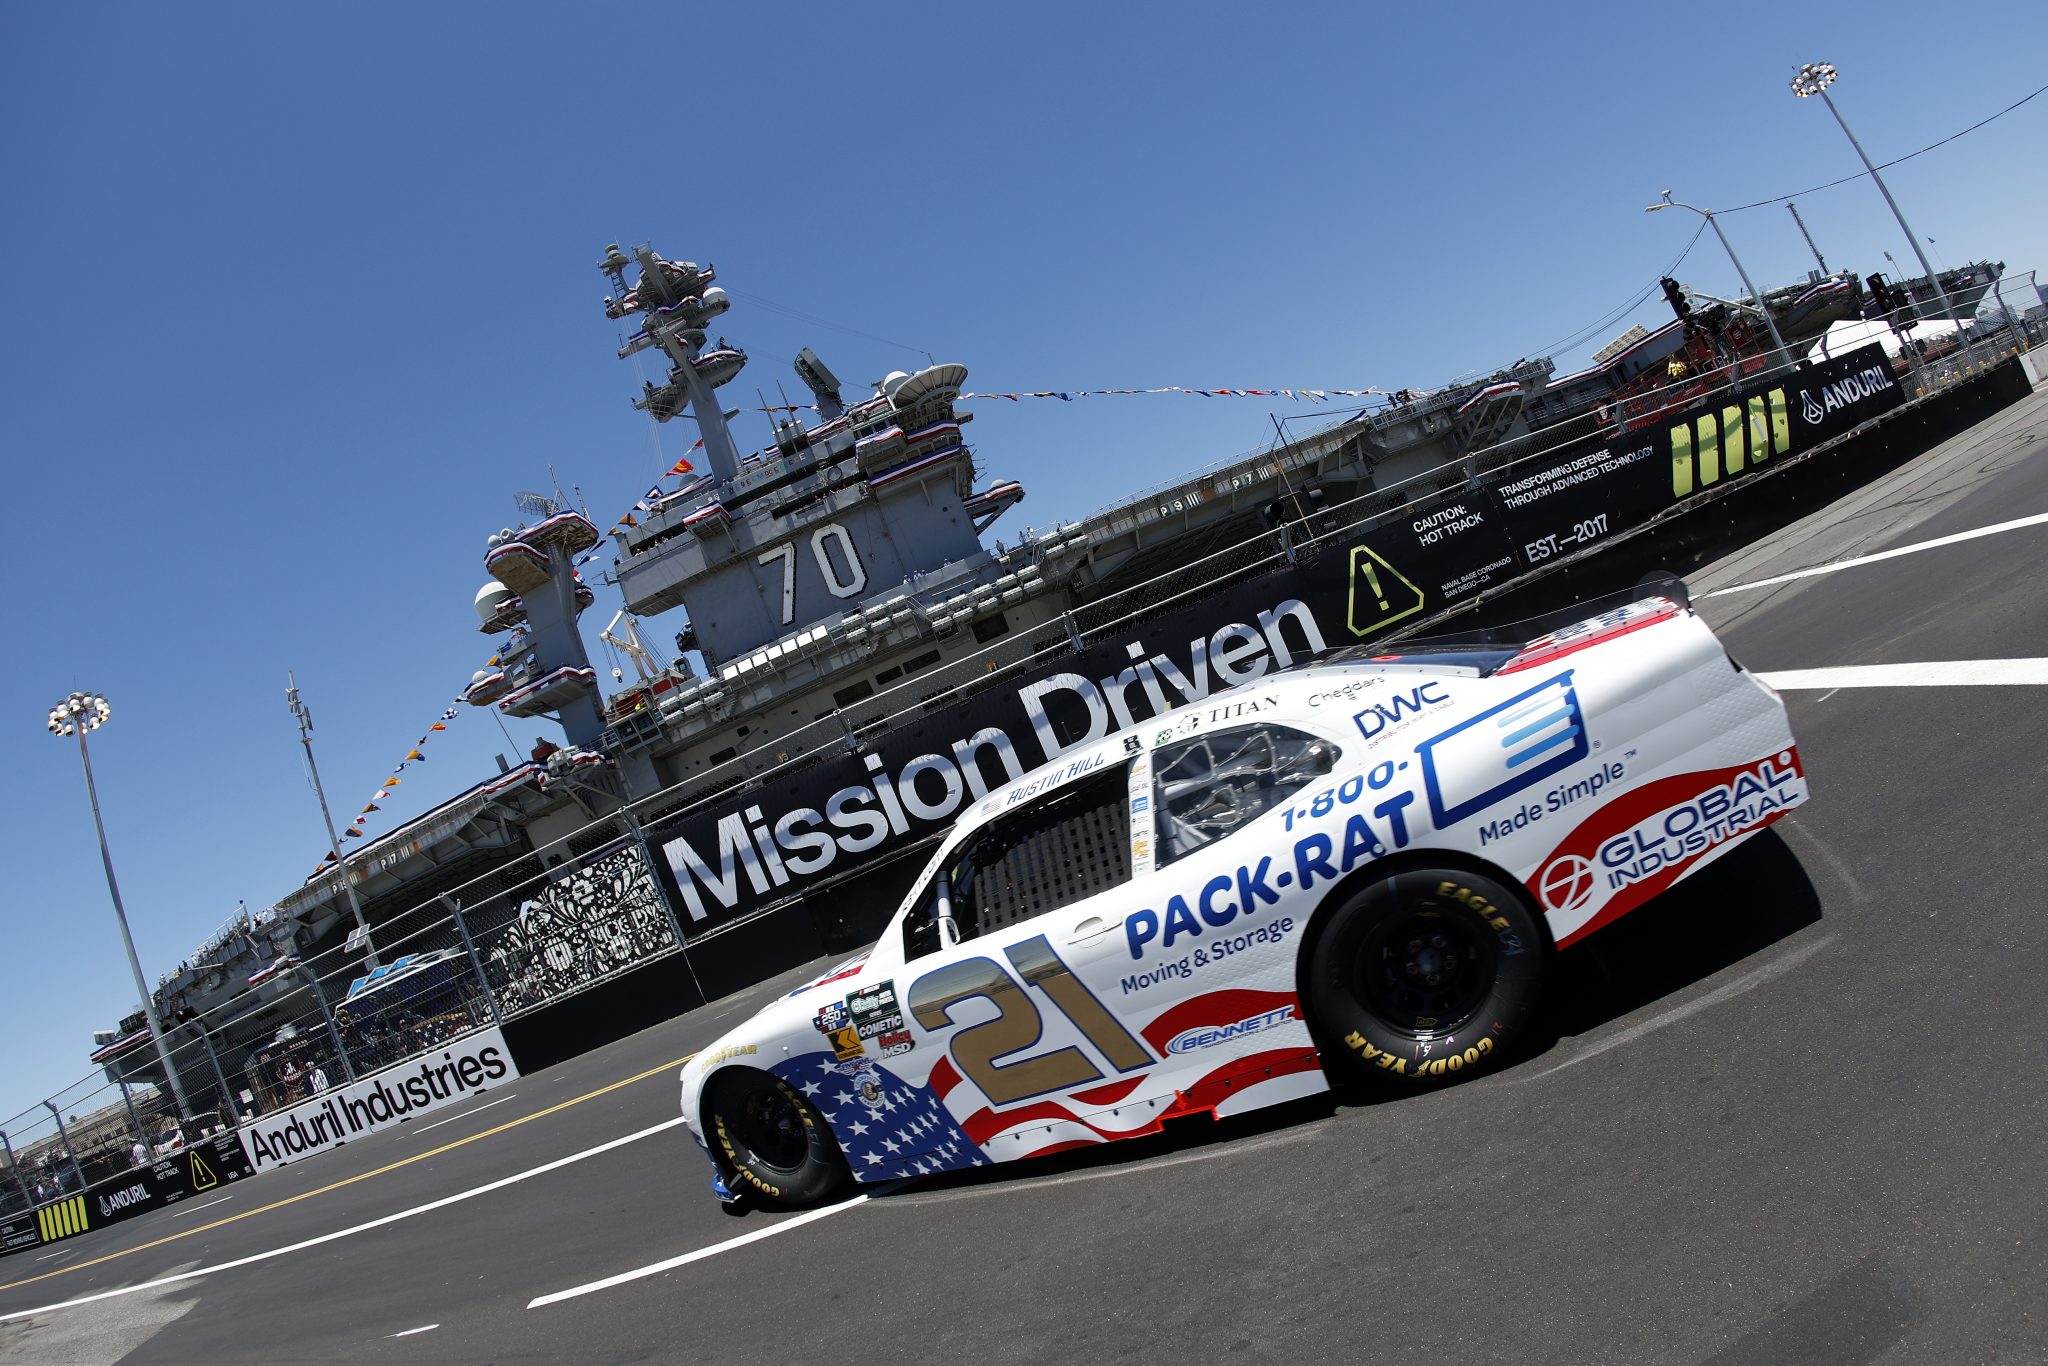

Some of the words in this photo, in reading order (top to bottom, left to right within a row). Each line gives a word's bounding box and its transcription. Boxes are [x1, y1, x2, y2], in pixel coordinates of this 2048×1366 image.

[1823, 364, 1894, 413] ANDURIL
[1498, 463, 1572, 497] TRANSFORMING
[1571, 448, 1611, 472] DEFENSE
[1503, 484, 1553, 509] THROUGH
[1552, 466, 1600, 493] ADVANCED
[1599, 445, 1653, 474] TECHNOLOGY
[1412, 504, 1467, 533] CAUTION:
[1418, 527, 1443, 547] HOT
[1443, 511, 1484, 541] TRACK
[758, 523, 869, 625] 70
[1441, 579, 1461, 592] NAVAL
[1461, 571, 1478, 583] BASE
[1477, 556, 1511, 576] CORONADO
[1444, 588, 1458, 599] SAN
[1208, 695, 1279, 723] TITAN
[1353, 681, 1449, 740] DWC
[662, 726, 1026, 921] Mission
[1018, 598, 1326, 761] Driven
[1007, 769, 1064, 805] AUSTIN
[1066, 752, 1104, 779] HILL
[1479, 799, 1543, 846] Made
[1546, 761, 1625, 814] Simple
[1600, 762, 1792, 868] GLOBAL
[1607, 788, 1799, 889] INDUSTRIAL
[1125, 790, 1414, 960] PACK-RAT
[1437, 881, 1511, 930] EAGLE
[1121, 957, 1192, 994] Moving
[1194, 950, 1212, 968] &
[1212, 916, 1295, 961] Storage
[822, 1010, 840, 1025] 250
[859, 1014, 901, 1037] COMETIC
[906, 933, 1158, 1107] 21
[1181, 1006, 1293, 1051] BENNETT
[883, 1042, 911, 1059] MSD
[250, 1099, 345, 1167] Anduril
[342, 1045, 507, 1134] Industries
[109, 1183, 151, 1211] ANDURIL
[227, 1170, 239, 1180] USA
